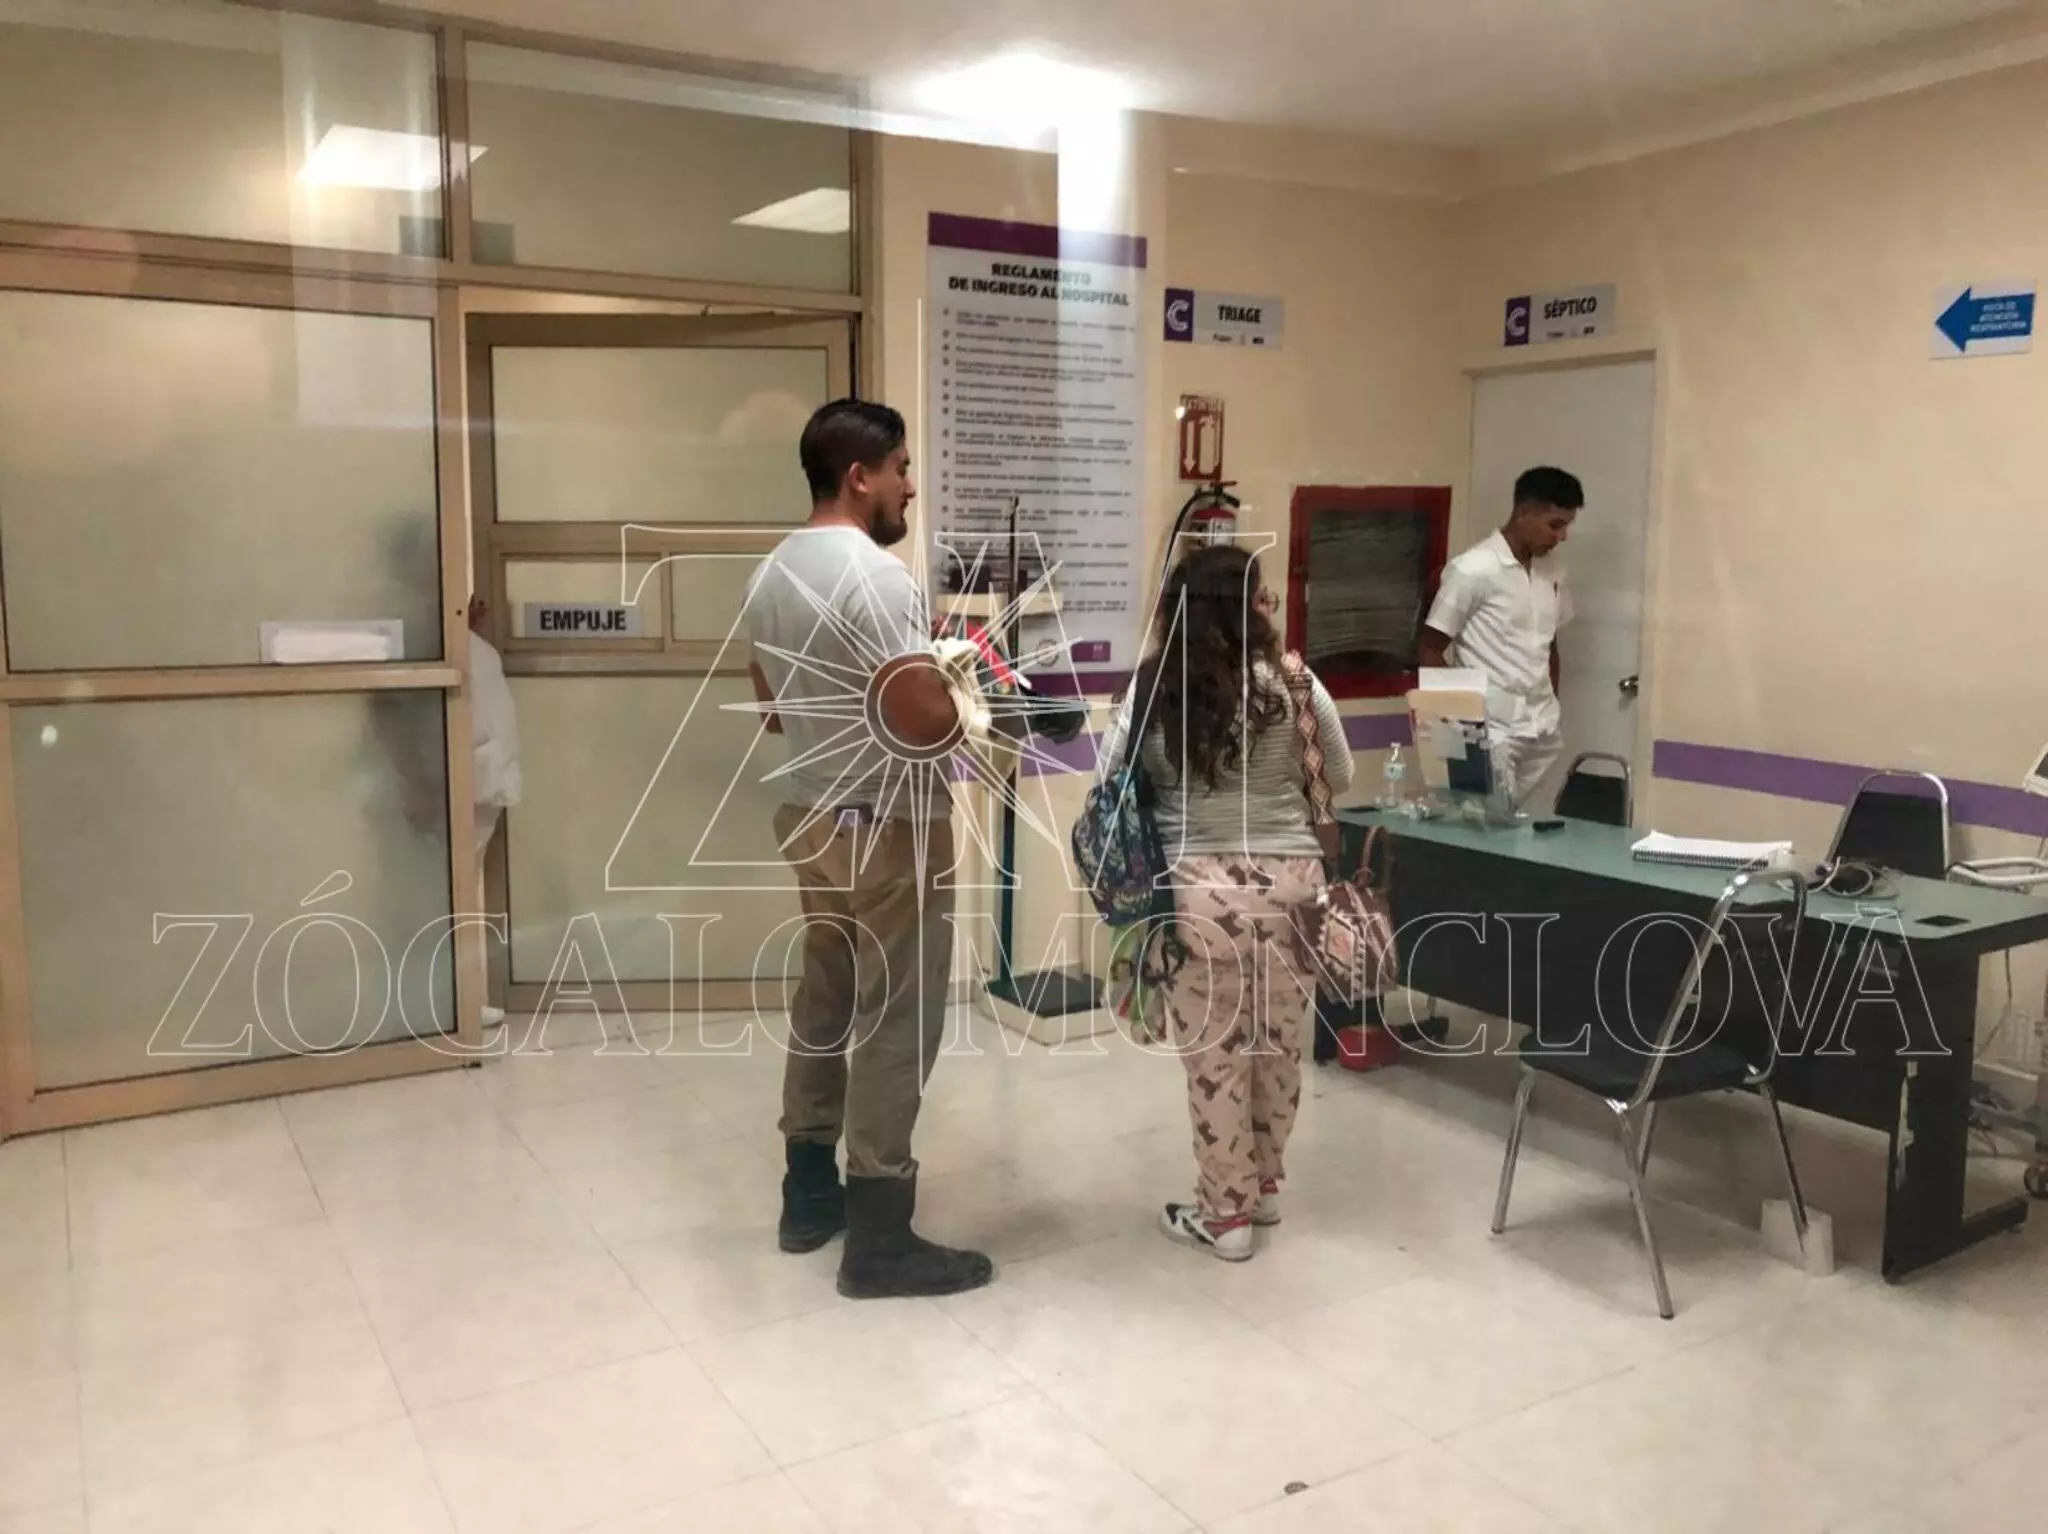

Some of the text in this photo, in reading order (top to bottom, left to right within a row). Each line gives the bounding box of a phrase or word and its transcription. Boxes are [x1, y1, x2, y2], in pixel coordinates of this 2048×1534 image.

[991, 263, 1091, 285] REGLAMENTO
[949, 277, 1130, 306] DE INGRESO AL HOSPITAL
[1217, 304, 1262, 324] TRIAGE
[1543, 296, 1598, 320] SÉPTICO
[540, 609, 627, 631] EMPUJE
